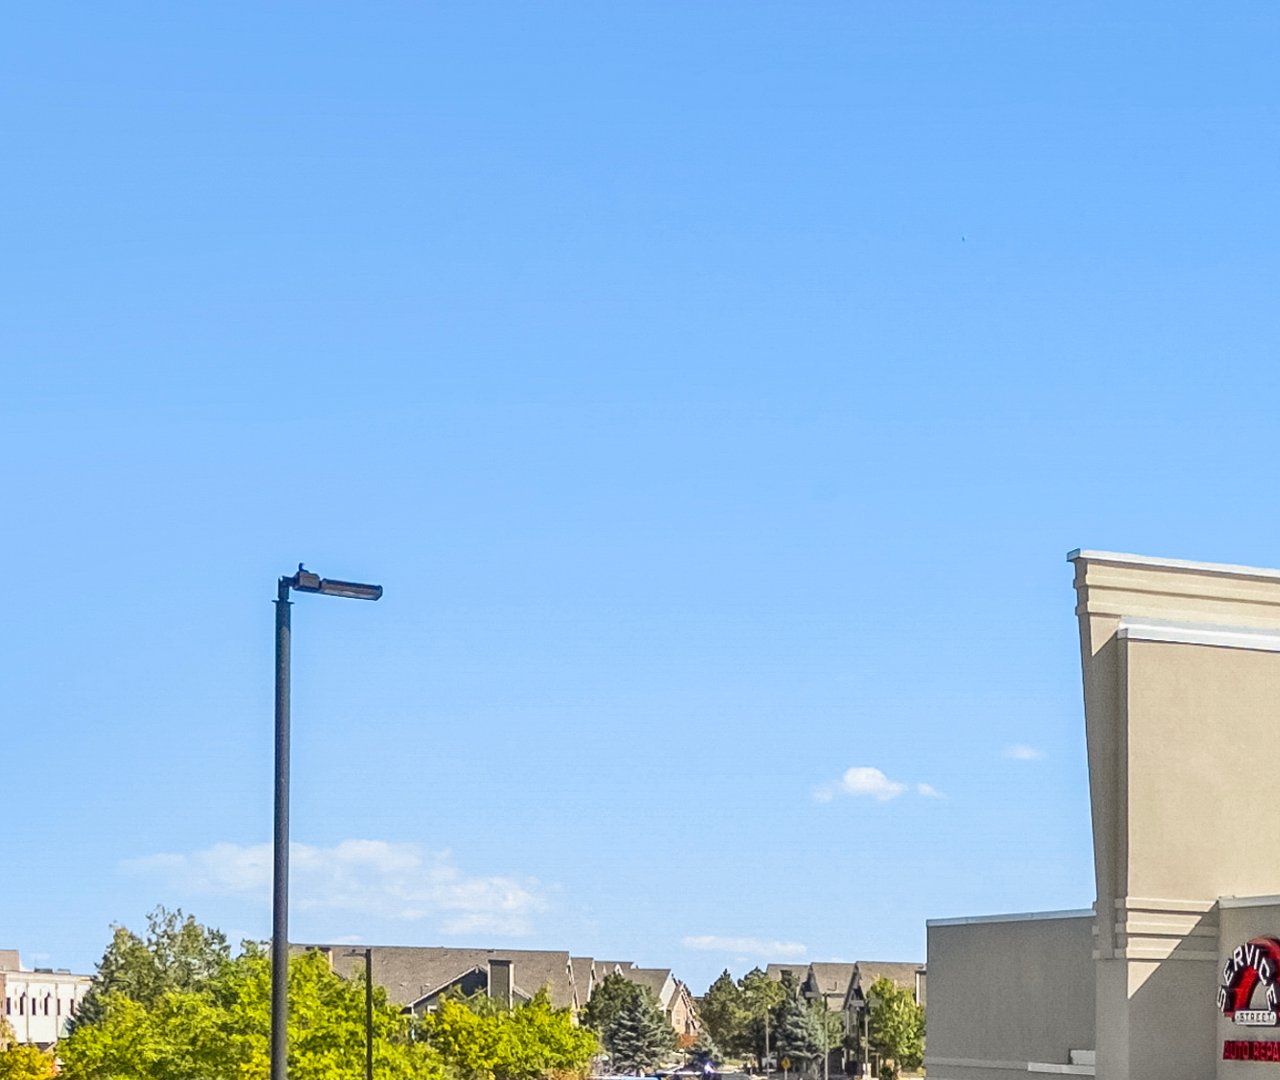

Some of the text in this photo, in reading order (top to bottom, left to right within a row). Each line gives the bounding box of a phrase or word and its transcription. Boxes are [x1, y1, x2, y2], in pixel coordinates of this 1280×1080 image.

[1217, 943, 1277, 1012] SERVICE
[1240, 1012, 1272, 1022] STREET
[1224, 1041, 1249, 1059] AUTO
